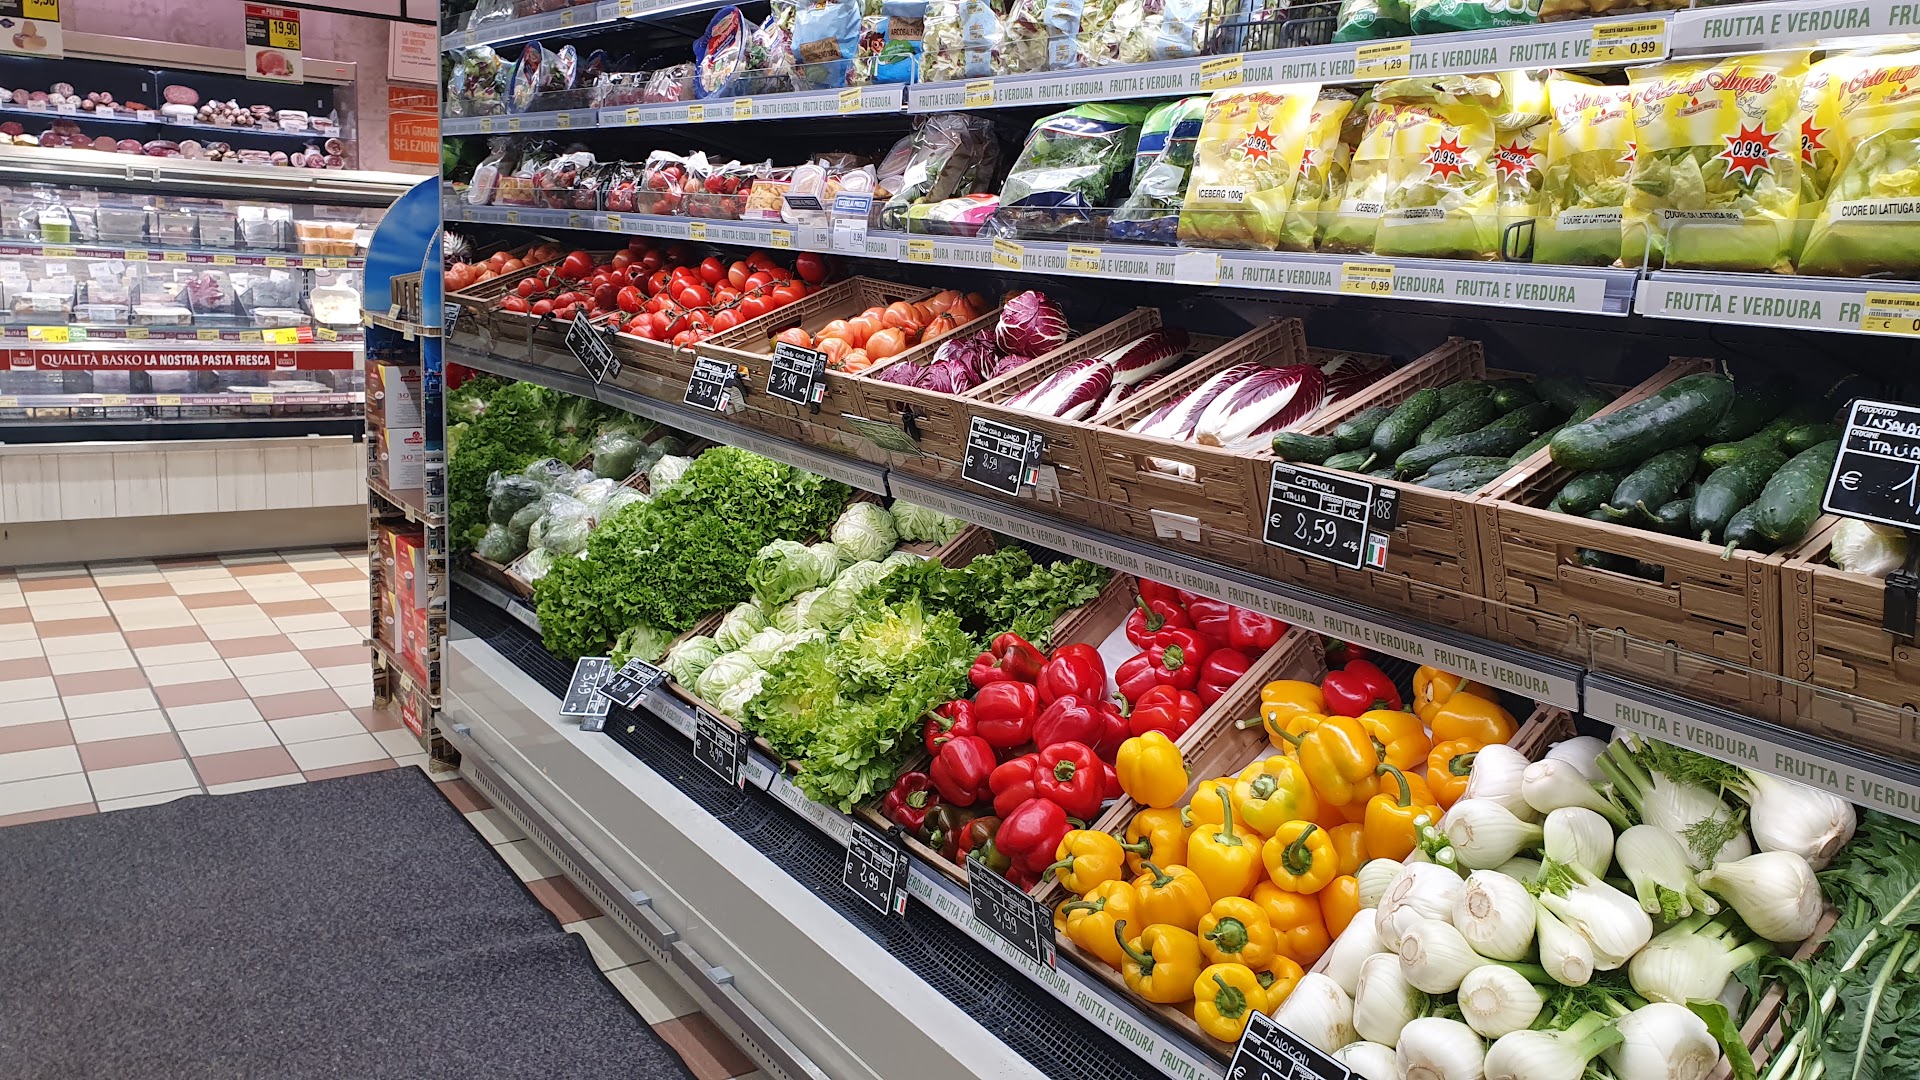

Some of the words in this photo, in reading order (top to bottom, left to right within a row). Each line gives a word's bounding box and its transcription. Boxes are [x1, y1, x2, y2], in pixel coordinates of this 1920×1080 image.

[273, 20, 297, 36] 19,90
[1703, 15, 1764, 39] FRUTTA
[1771, 14, 1782, 34] E
[1787, 7, 1870, 33] VERDURA
[1889, 4, 1920, 27] FRU
[1630, 41, 1656, 55] 0,99
[1383, 59, 1402, 72] 1,29
[919, 95, 938, 107] FRUTTA
[1004, 87, 1033, 100] VERDURA
[1038, 84, 1064, 98] FRUTTA
[1065, 83, 1069, 96] E
[1071, 80, 1104, 95] VERDURA
[1109, 79, 1135, 93] FRUTTA
[1140, 77, 1144, 91] E
[1146, 74, 1183, 89] VERDURA
[1281, 63, 1317, 81] FRUTTA
[1320, 62, 1326, 76] E
[1329, 59, 1355, 76] VERD
[1432, 52, 1438, 68] E
[1442, 47, 1497, 67] VERDURA
[1509, 42, 1557, 63] FRUTTA
[1561, 41, 1570, 58] E
[1222, 70, 1237, 83] 1,29
[868, 95, 892, 108] VERDURA
[411, 126, 437, 137] GRAND
[393, 138, 437, 153] SELEZION
[1733, 141, 1768, 157] 0.99€
[1433, 149, 1460, 164] 0.99€
[1199, 188, 1226, 199] ICEBERG
[1228, 189, 1243, 200] 100g
[1355, 203, 1379, 213] ICEBERG
[1842, 204, 1868, 216] CUORE
[1869, 204, 1878, 215] DI
[1879, 203, 1914, 215] LATTUGA
[953, 249, 974, 262] FRUTTA
[1114, 260, 1149, 275] VERDURA
[1242, 267, 1275, 283] FRUTTA
[1278, 269, 1284, 283] E
[1286, 269, 1332, 286] VERDURA
[1393, 275, 1444, 294] VERDURA
[1455, 279, 1500, 298] FRUTTA
[1504, 281, 1511, 298] E
[1515, 282, 1575, 304] VERDURA
[1370, 280, 1390, 292] 0,99
[1664, 291, 1722, 313] FRUTTA
[1728, 295, 1738, 314] E
[1742, 296, 1822, 320] VERDURA
[41, 352, 99, 367] QUALITÀ
[102, 353, 142, 366] BASKO
[144, 354, 158, 366] LA
[160, 354, 200, 366] NOSTRA
[202, 354, 233, 366] PASTA
[235, 355, 271, 366] FRESCA
[1858, 406, 1899, 417] PRODOTTO
[1865, 413, 1920, 436] INSALA
[967, 455, 975, 467] €
[1295, 475, 1335, 494] CETRIOLI
[1838, 470, 1863, 491] €
[1282, 491, 1307, 503] ITALIA
[1270, 513, 1282, 528] €
[1293, 512, 1337, 548] 2,59
[899, 486, 917, 500] FRUTTA
[921, 493, 947, 511] VERDURA
[950, 502, 971, 519] FRUTTA
[976, 511, 1004, 528] VERDURA
[1007, 520, 1030, 537] FRUTTA
[1037, 528, 1067, 548] VERDURA
[1071, 539, 1098, 558] FRUTTA
[1099, 548, 1104, 560] E
[1104, 550, 1139, 571] VERDURA
[1145, 562, 1173, 581] FRUTTA
[1175, 572, 1181, 584] E
[1181, 574, 1221, 596] VERDURA
[1228, 587, 1261, 609] FRUTTA
[1263, 597, 1269, 610] E
[1271, 599, 1316, 625] VERDURA
[1323, 615, 1361, 638] FRUTTA
[1365, 627, 1371, 641] E
[1373, 629, 1424, 658] VERDURA
[1434, 648, 1477, 674] FRUTTA
[1481, 661, 1488, 677] E
[1491, 664, 1550, 696] VERDURA
[1615, 702, 1668, 733] FRUTTA
[1673, 720, 1681, 737] E
[1686, 724, 1759, 763] VERDURA
[1775, 752, 1838, 789] FRUTTA
[1846, 774, 1855, 793] E
[1861, 779, 1920, 815] VERDU
[860, 863, 879, 891] 2,99
[993, 903, 1018, 935] 2,99
[780, 784, 796, 804] FRUTTA
[801, 799, 825, 823] VERDURA
[826, 817, 846, 839] FRUTTA
[935, 893, 960, 920] FRUTTA
[960, 909, 965, 923] E
[965, 914, 996, 946] VERDURA
[1000, 940, 1029, 968] FRUTTA
[1028, 959, 1034, 972] E
[1034, 963, 1071, 997] VERDURA
[1075, 990, 1105, 1023] FRUTTA
[1106, 1010, 1114, 1027] E
[1114, 1016, 1155, 1056] VERDURA
[1160, 1049, 1196, 1080] FRUTTA
[1265, 1029, 1310, 1066] FINOCCHI
[1257, 1046, 1282, 1071] ITALIA
